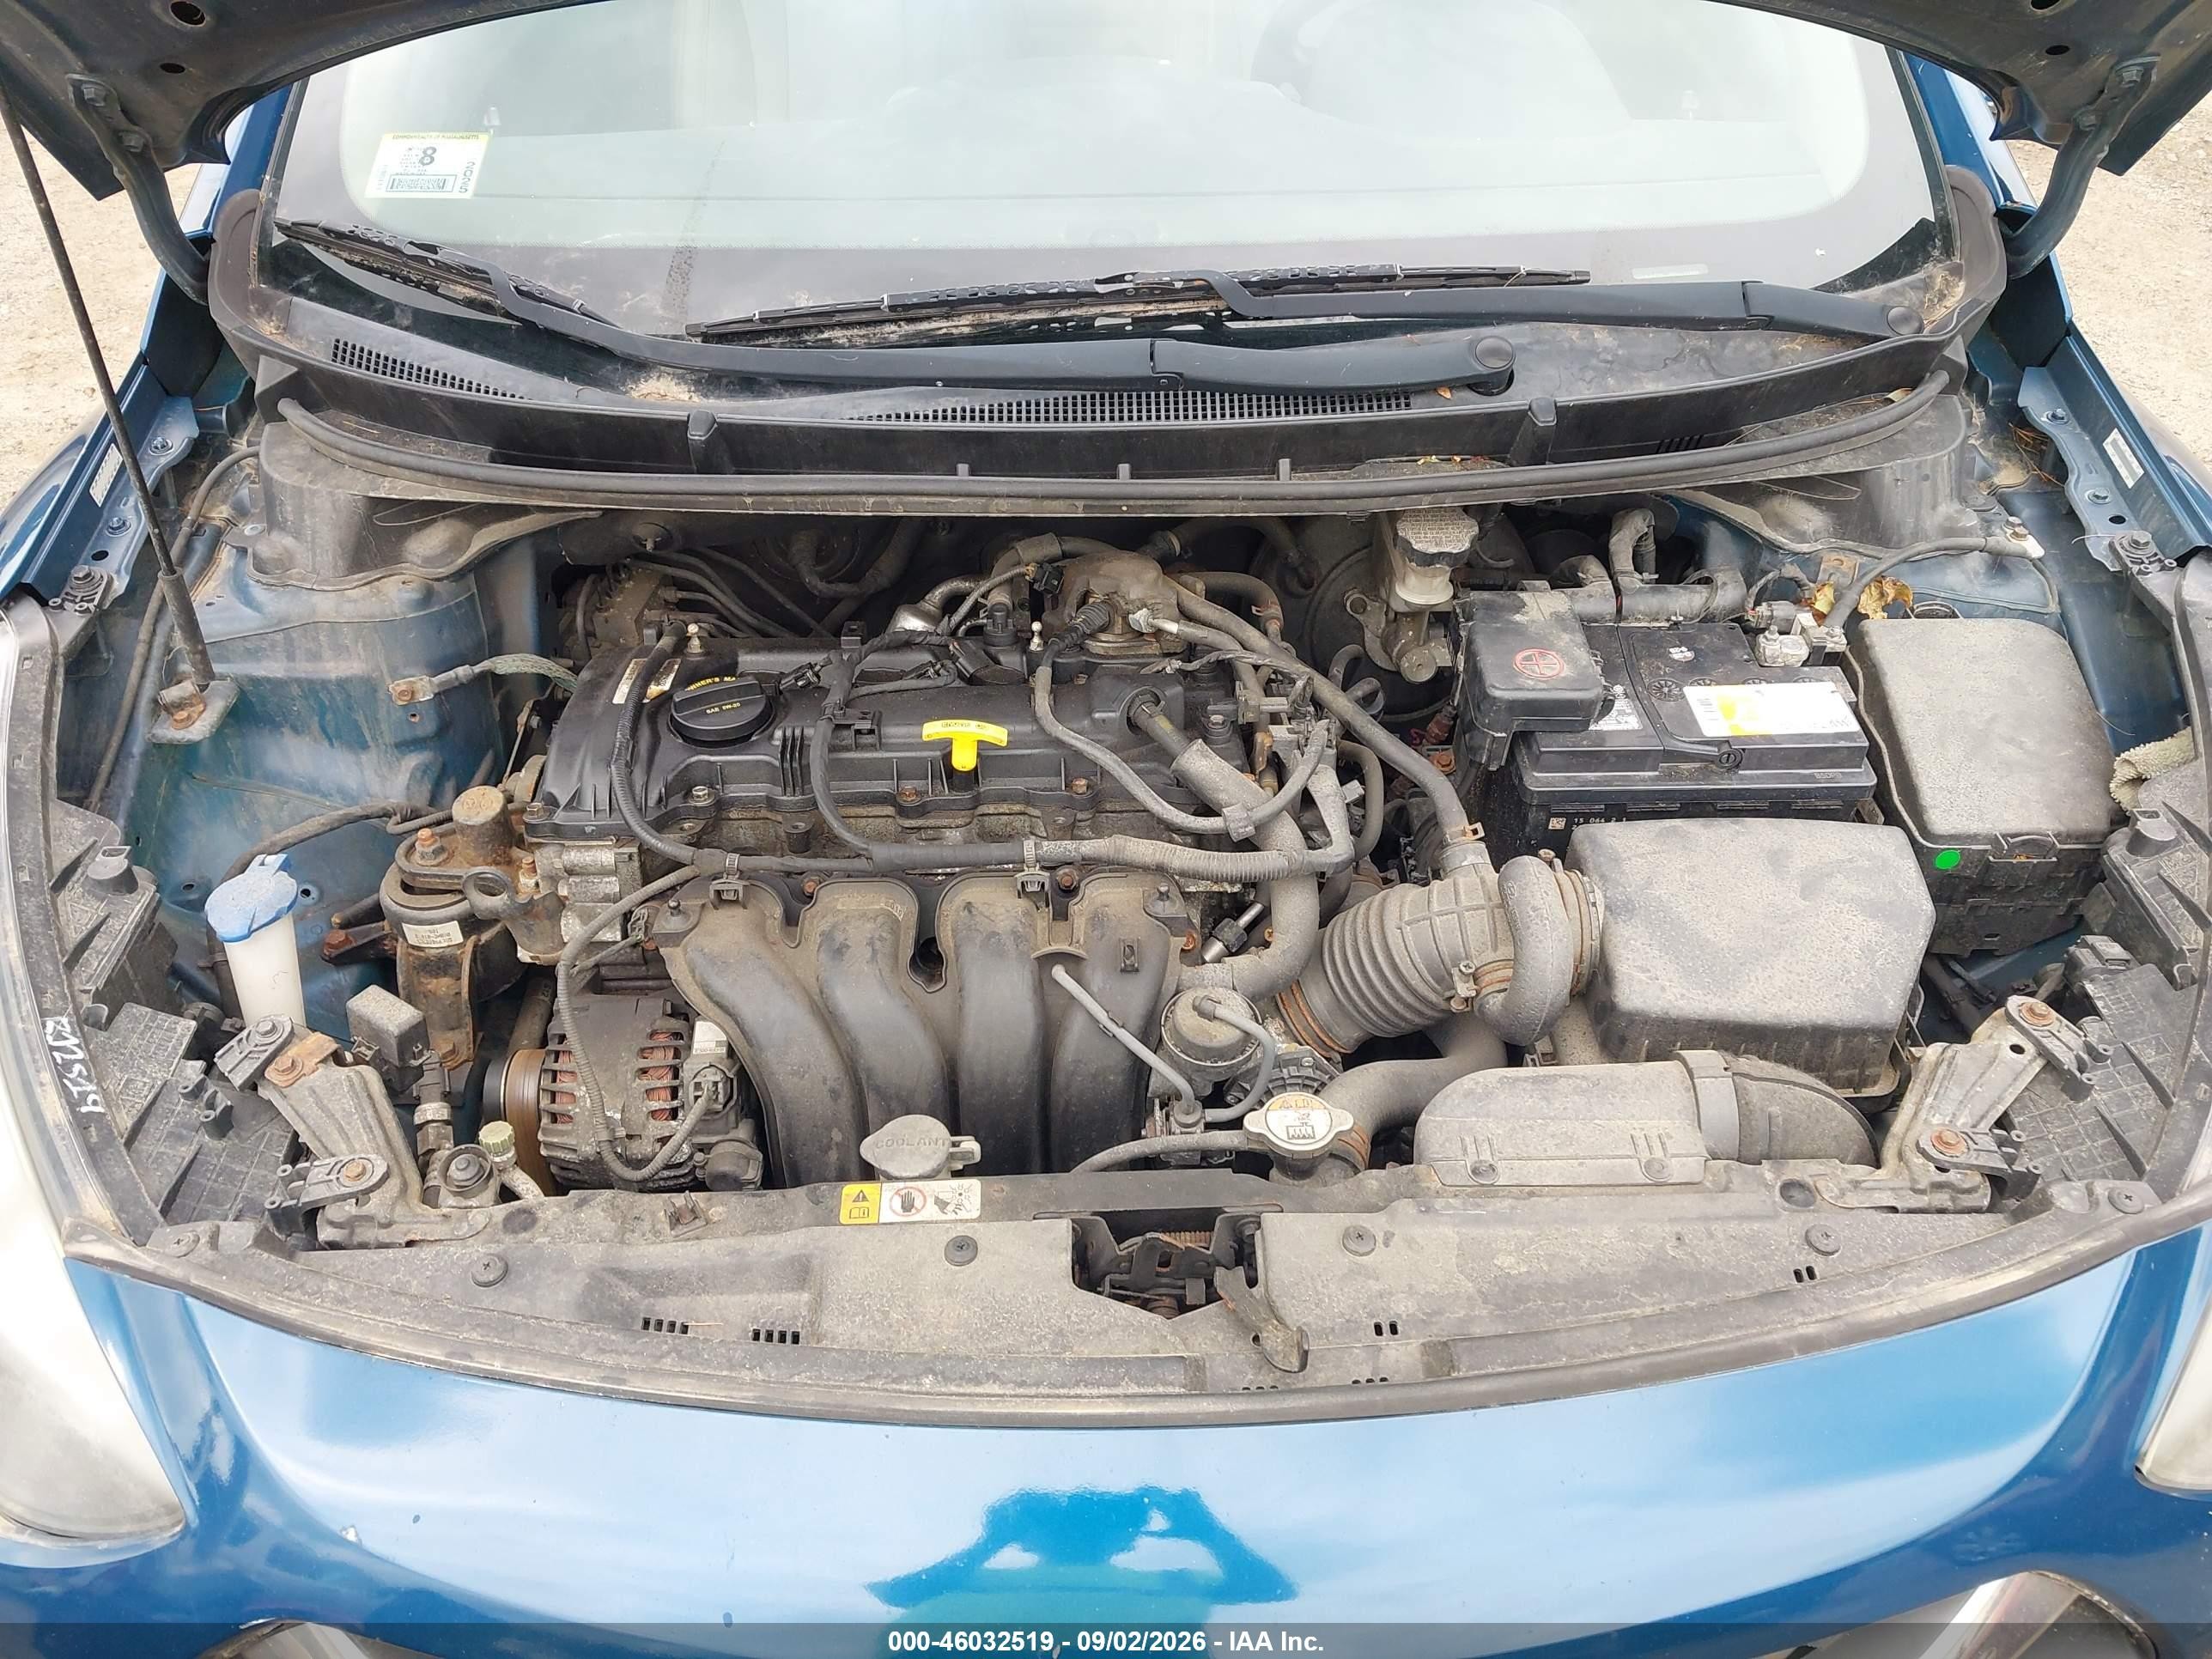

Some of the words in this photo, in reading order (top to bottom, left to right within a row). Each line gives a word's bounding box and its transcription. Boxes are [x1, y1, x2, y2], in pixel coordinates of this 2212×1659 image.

[419, 146, 437, 167] 8
[459, 161, 476, 193] 2025
[875, 1136, 950, 1149] COOLANT
